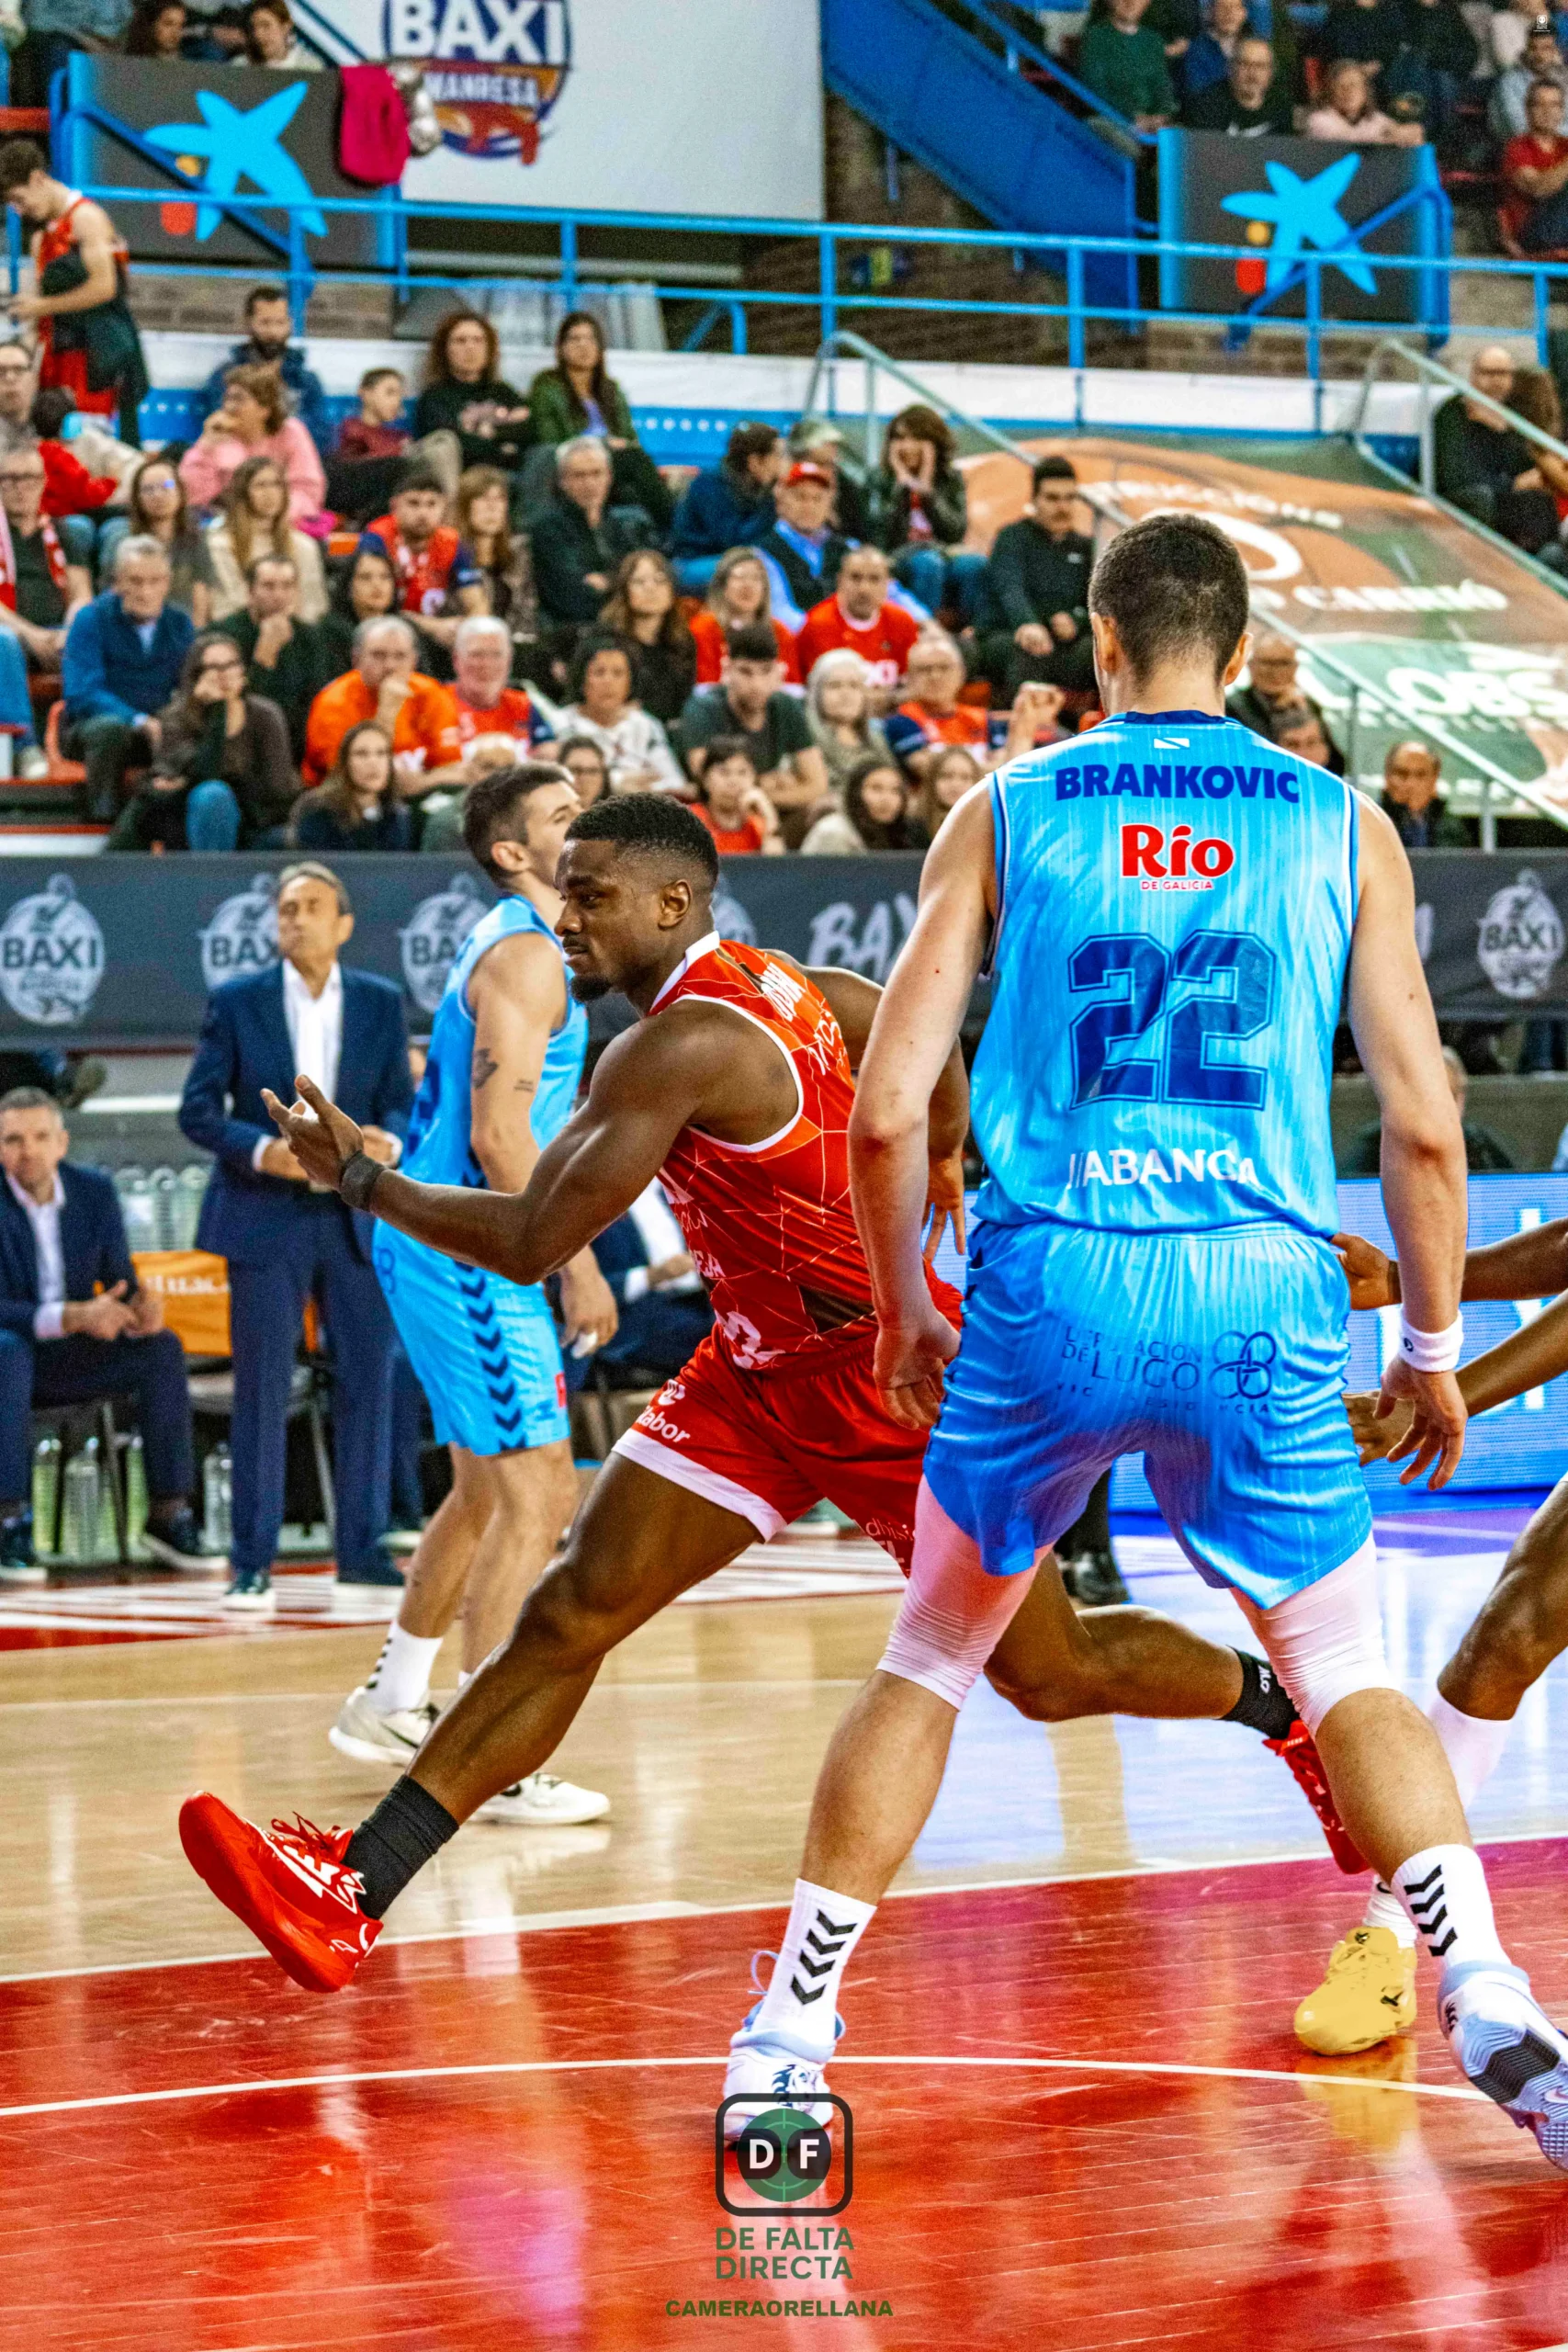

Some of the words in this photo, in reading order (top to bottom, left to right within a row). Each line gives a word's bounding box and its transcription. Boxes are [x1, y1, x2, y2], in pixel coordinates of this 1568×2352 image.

[389, 0, 564, 63] BAXI
[1055, 763, 1300, 804] BRANKOVIC
[1121, 823, 1235, 879] Río
[1141, 880, 1159, 891] DE
[1162, 879, 1213, 891] GALICIA
[4, 936, 96, 968] BAXI
[1068, 929, 1278, 1111] 22
